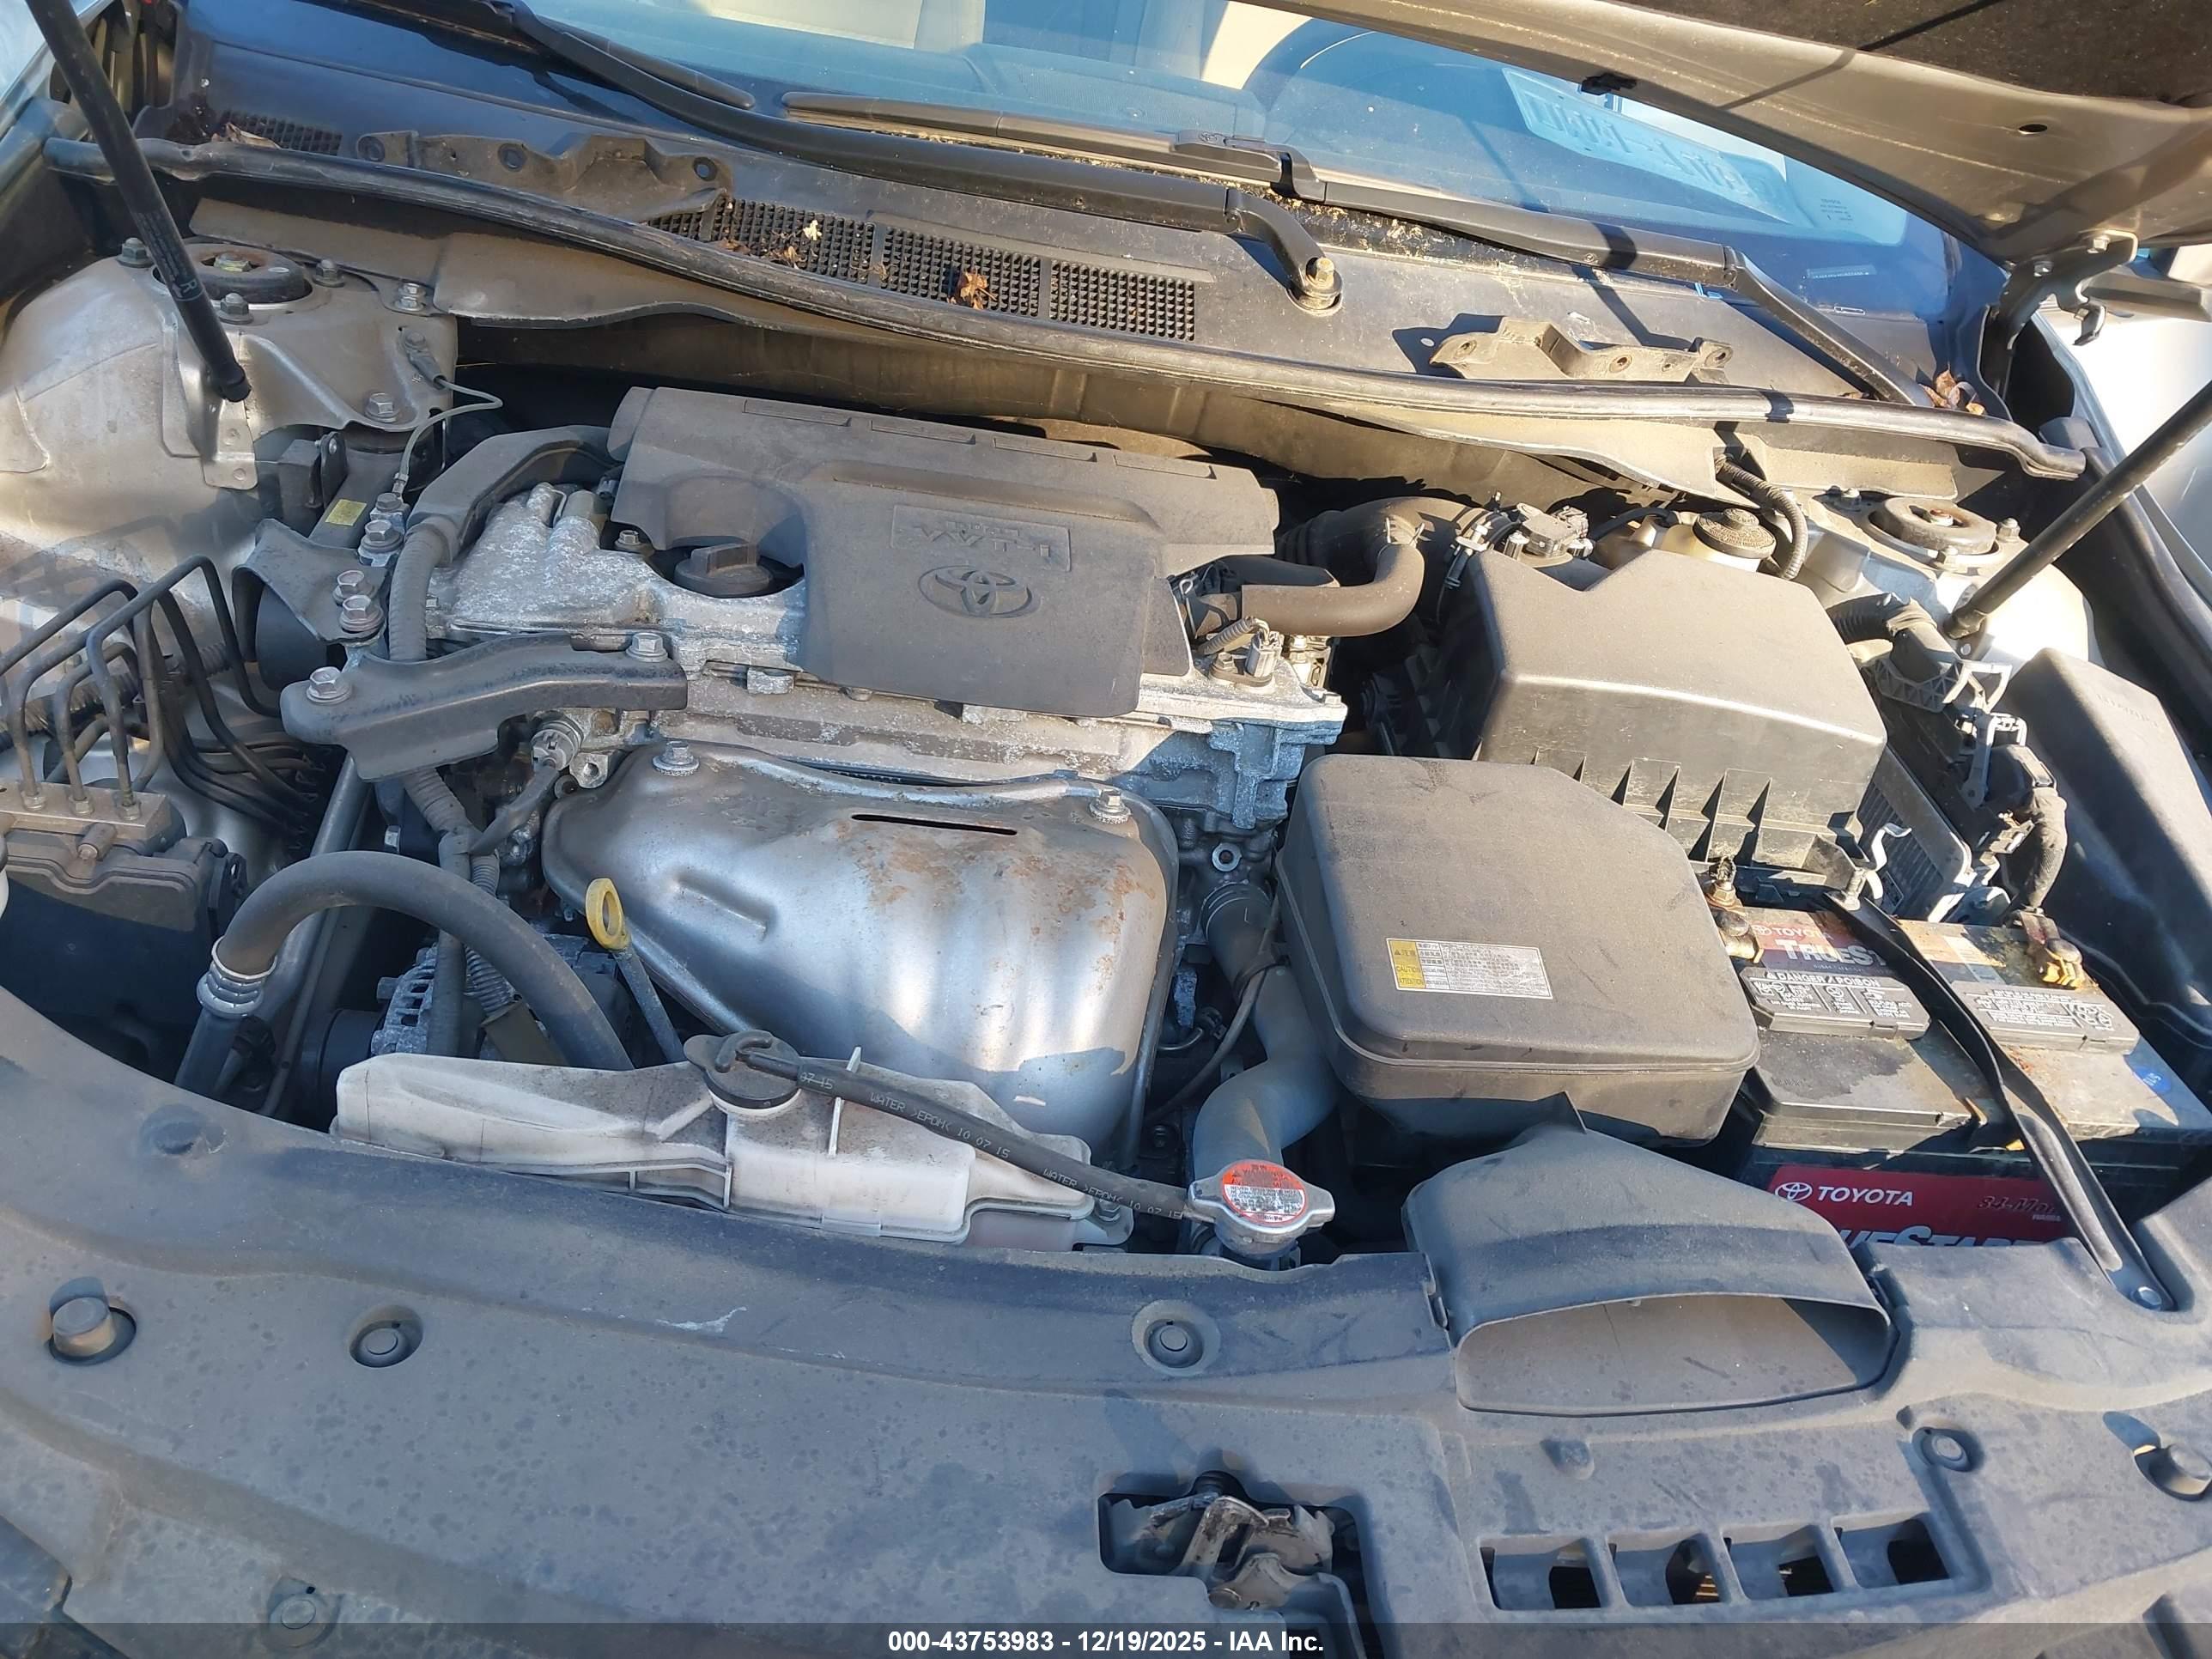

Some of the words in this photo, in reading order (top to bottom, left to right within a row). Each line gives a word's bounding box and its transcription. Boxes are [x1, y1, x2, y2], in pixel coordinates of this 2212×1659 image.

[179, 278, 198, 294] R
[1778, 973, 1825, 984] DANGER
[1836, 977, 1880, 988] POISON
[870, 1091, 906, 1113] WATER
[957, 1127, 971, 1139] 10
[975, 1136, 992, 1149] 07
[996, 1146, 1011, 1158] 15
[1042, 1167, 1078, 1188] WATER
[1129, 1200, 1141, 1211] 10
[1817, 1185, 1914, 1207] TOYOTA
